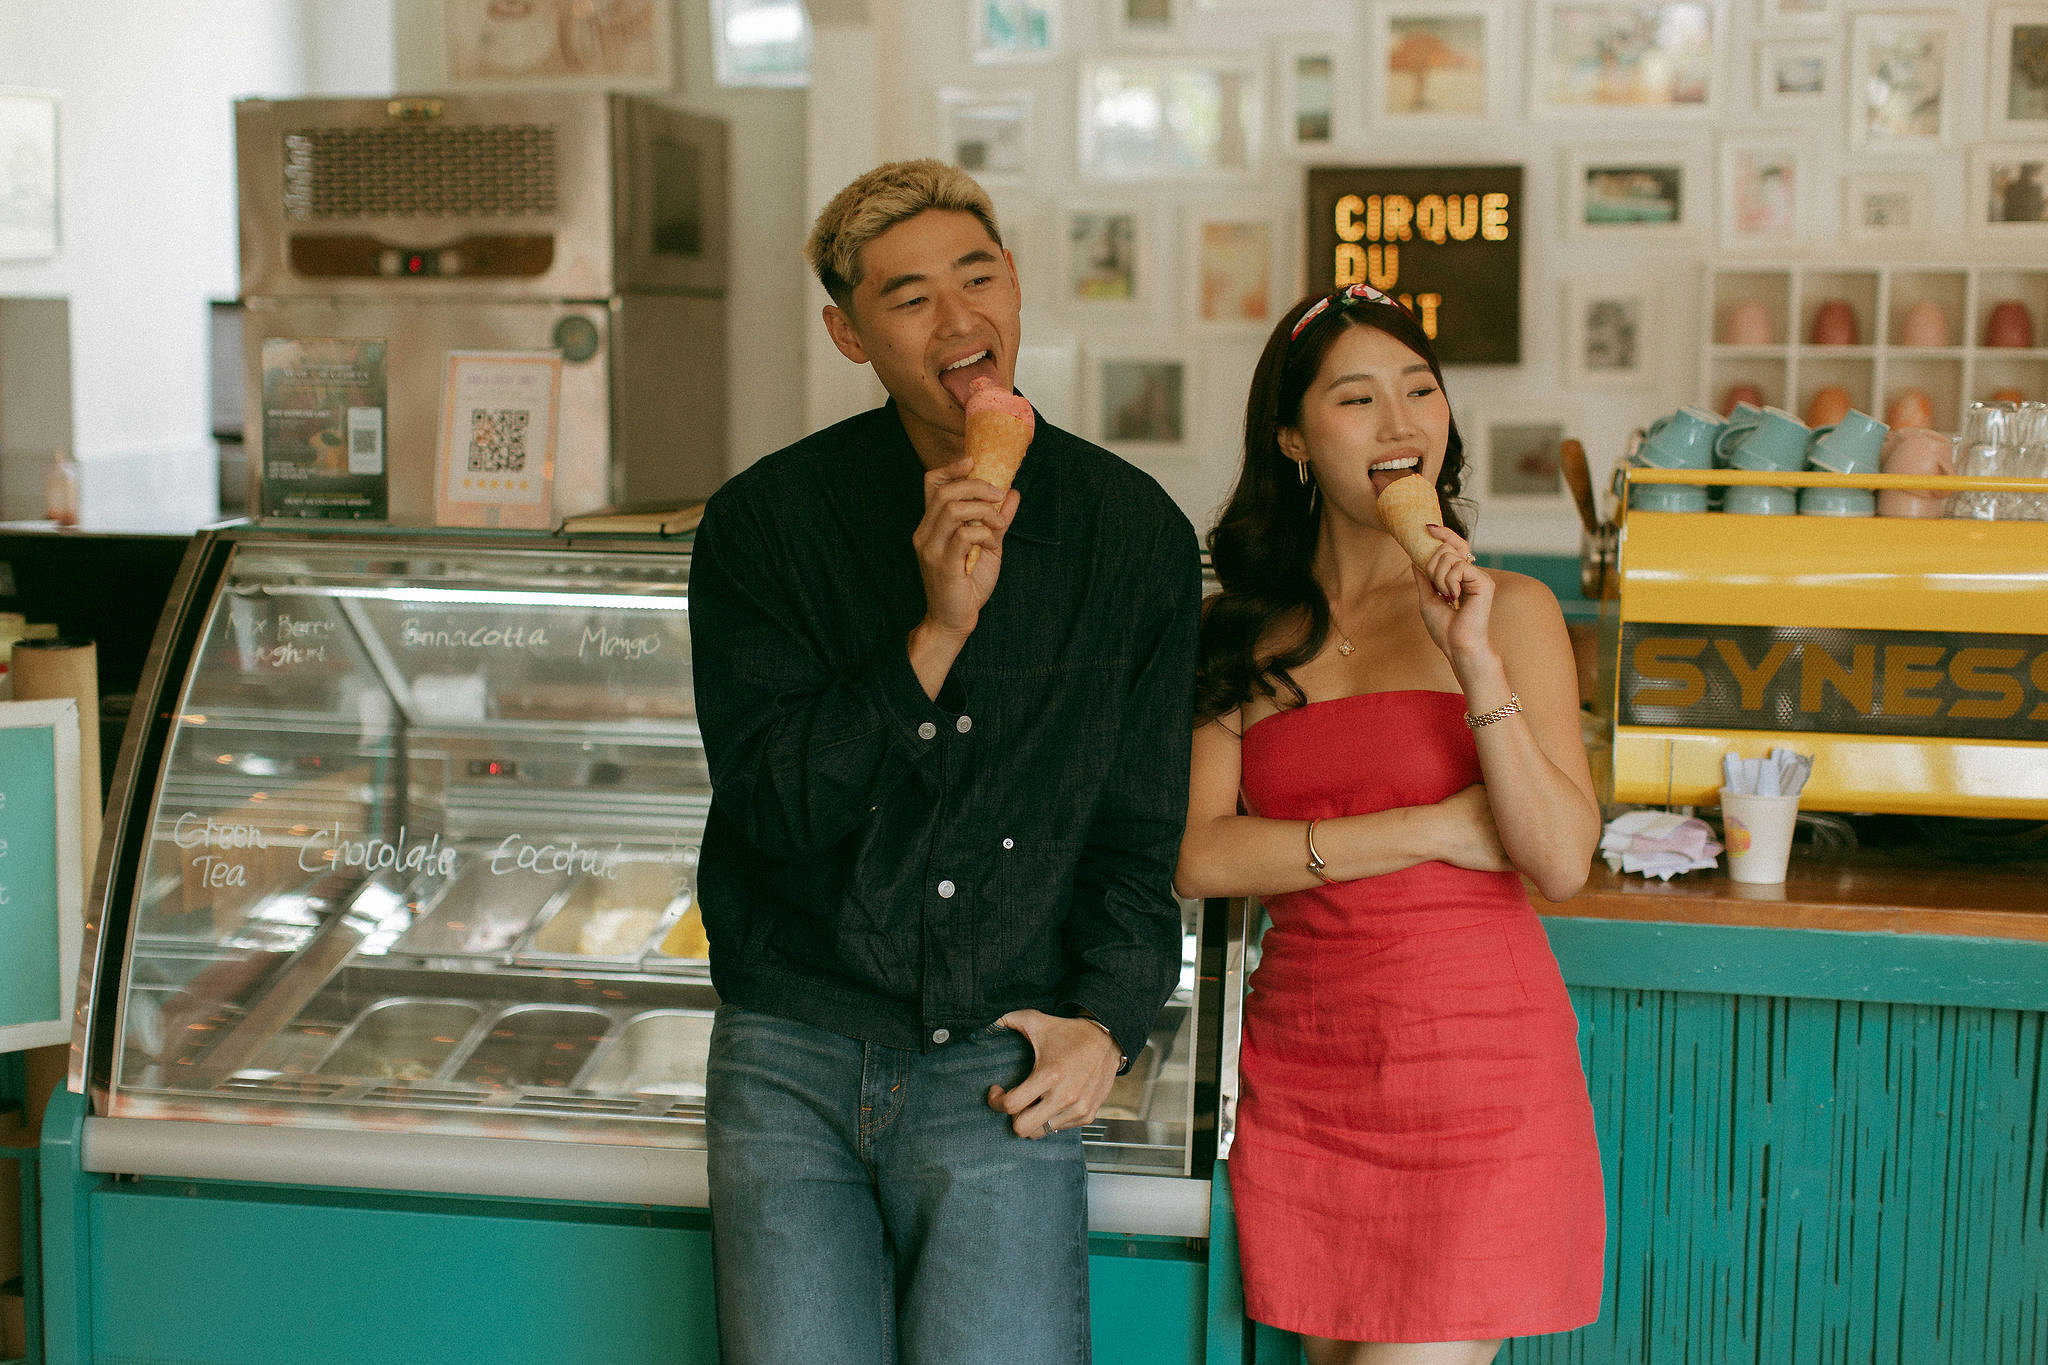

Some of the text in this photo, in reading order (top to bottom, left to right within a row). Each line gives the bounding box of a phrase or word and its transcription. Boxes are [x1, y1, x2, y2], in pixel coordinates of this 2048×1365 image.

[1335, 193, 1509, 245] CIRQUE
[1335, 243, 1399, 290] DU
[579, 625, 661, 660] Mango
[1632, 638, 2048, 721] SYNES
[174, 812, 267, 850] Green
[299, 821, 457, 880] Chocolate
[192, 855, 248, 889] Tea
[491, 833, 622, 880] Coconut
